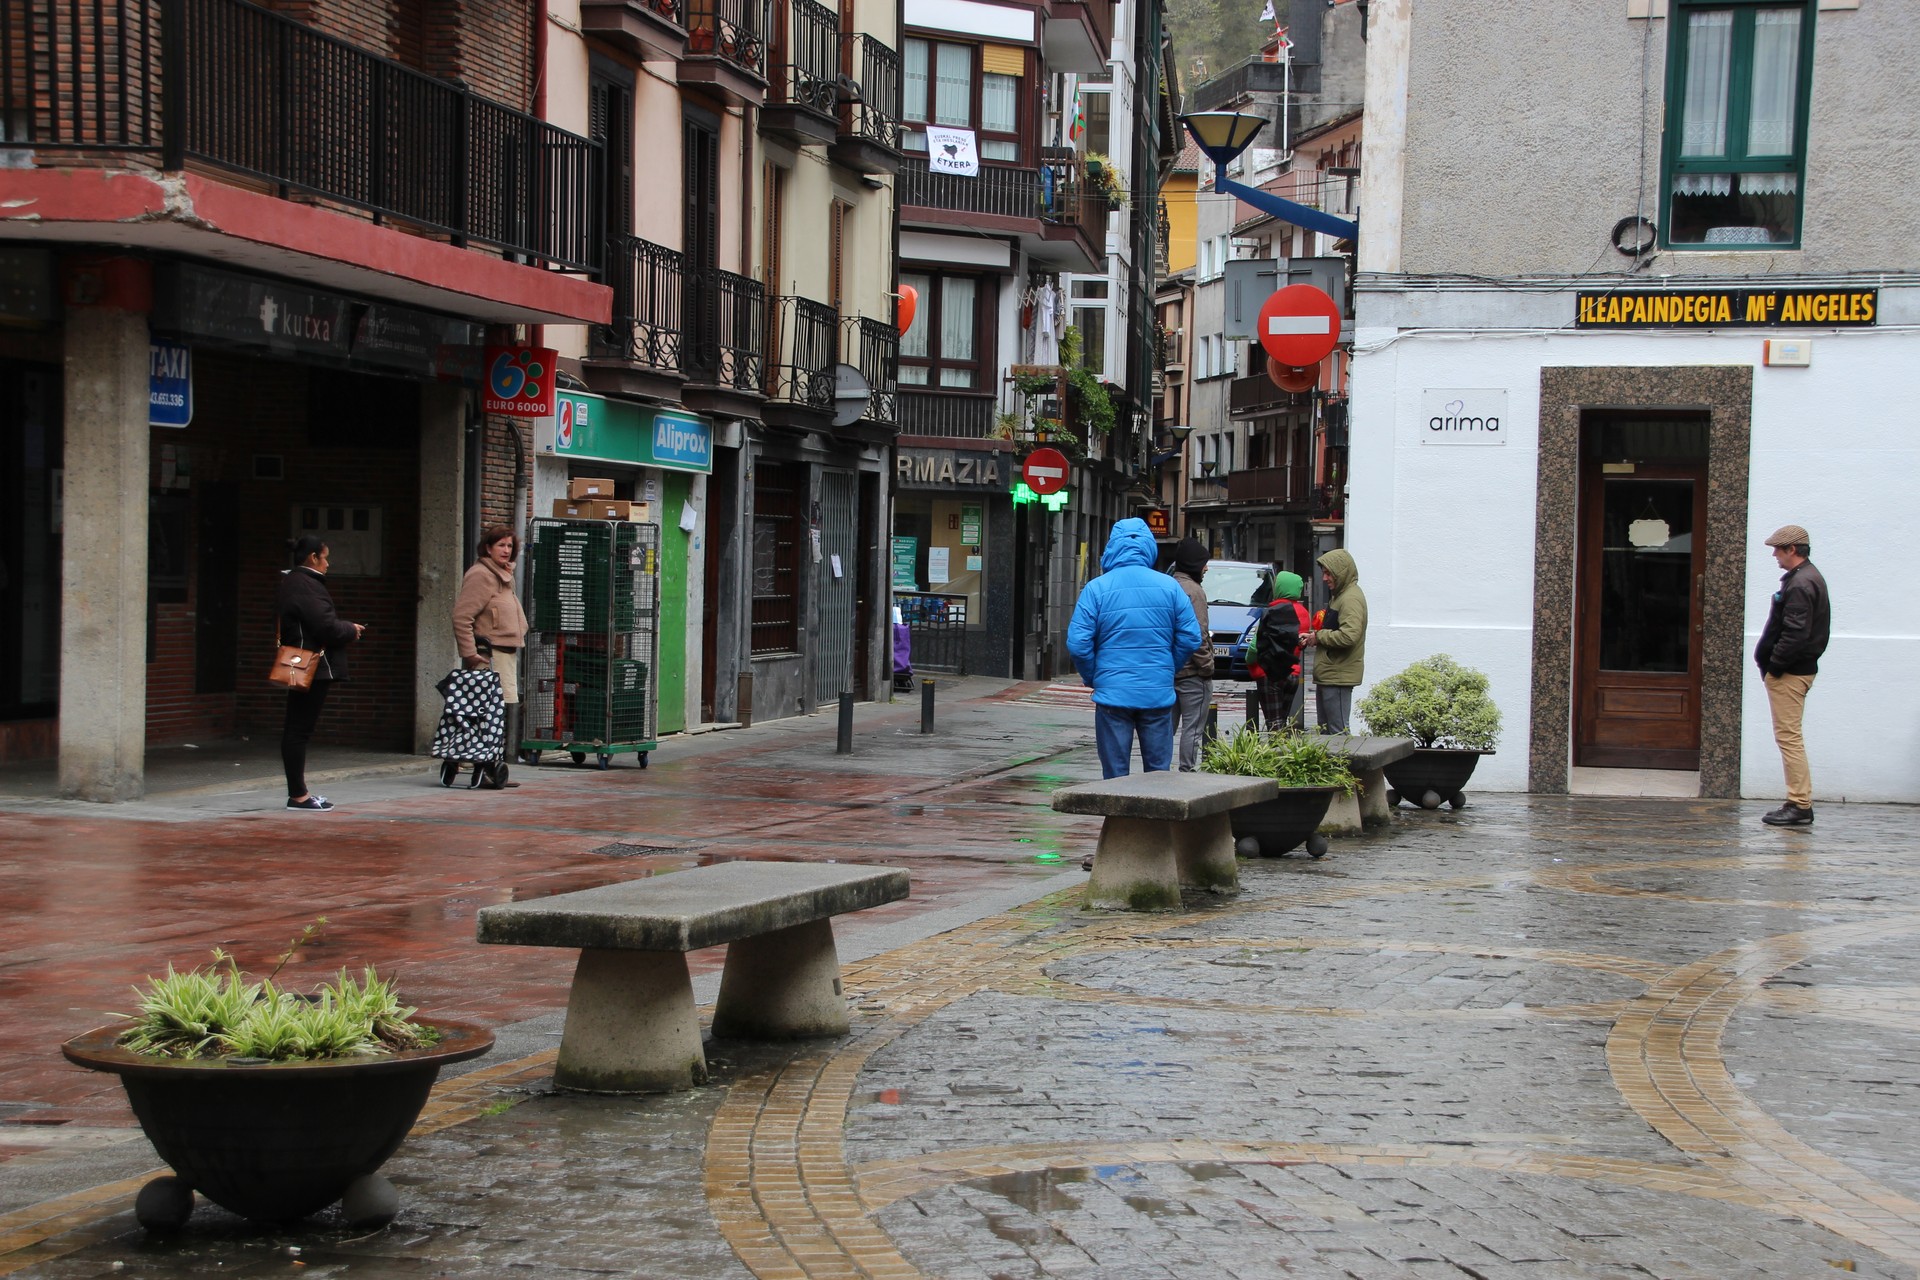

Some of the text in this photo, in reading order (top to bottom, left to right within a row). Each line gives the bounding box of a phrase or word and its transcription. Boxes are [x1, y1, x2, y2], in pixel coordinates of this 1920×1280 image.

[937, 157, 971, 168] ETXERA
[283, 302, 331, 342] kutxa
[1580, 295, 1731, 323] ILEAPAINDEGIA
[1780, 293, 1874, 322] ANGELES
[150, 345, 187, 379] TAXI
[486, 400, 546, 413] EURO 6000
[1429, 415, 1499, 432] arima
[656, 423, 706, 456] Aliprox
